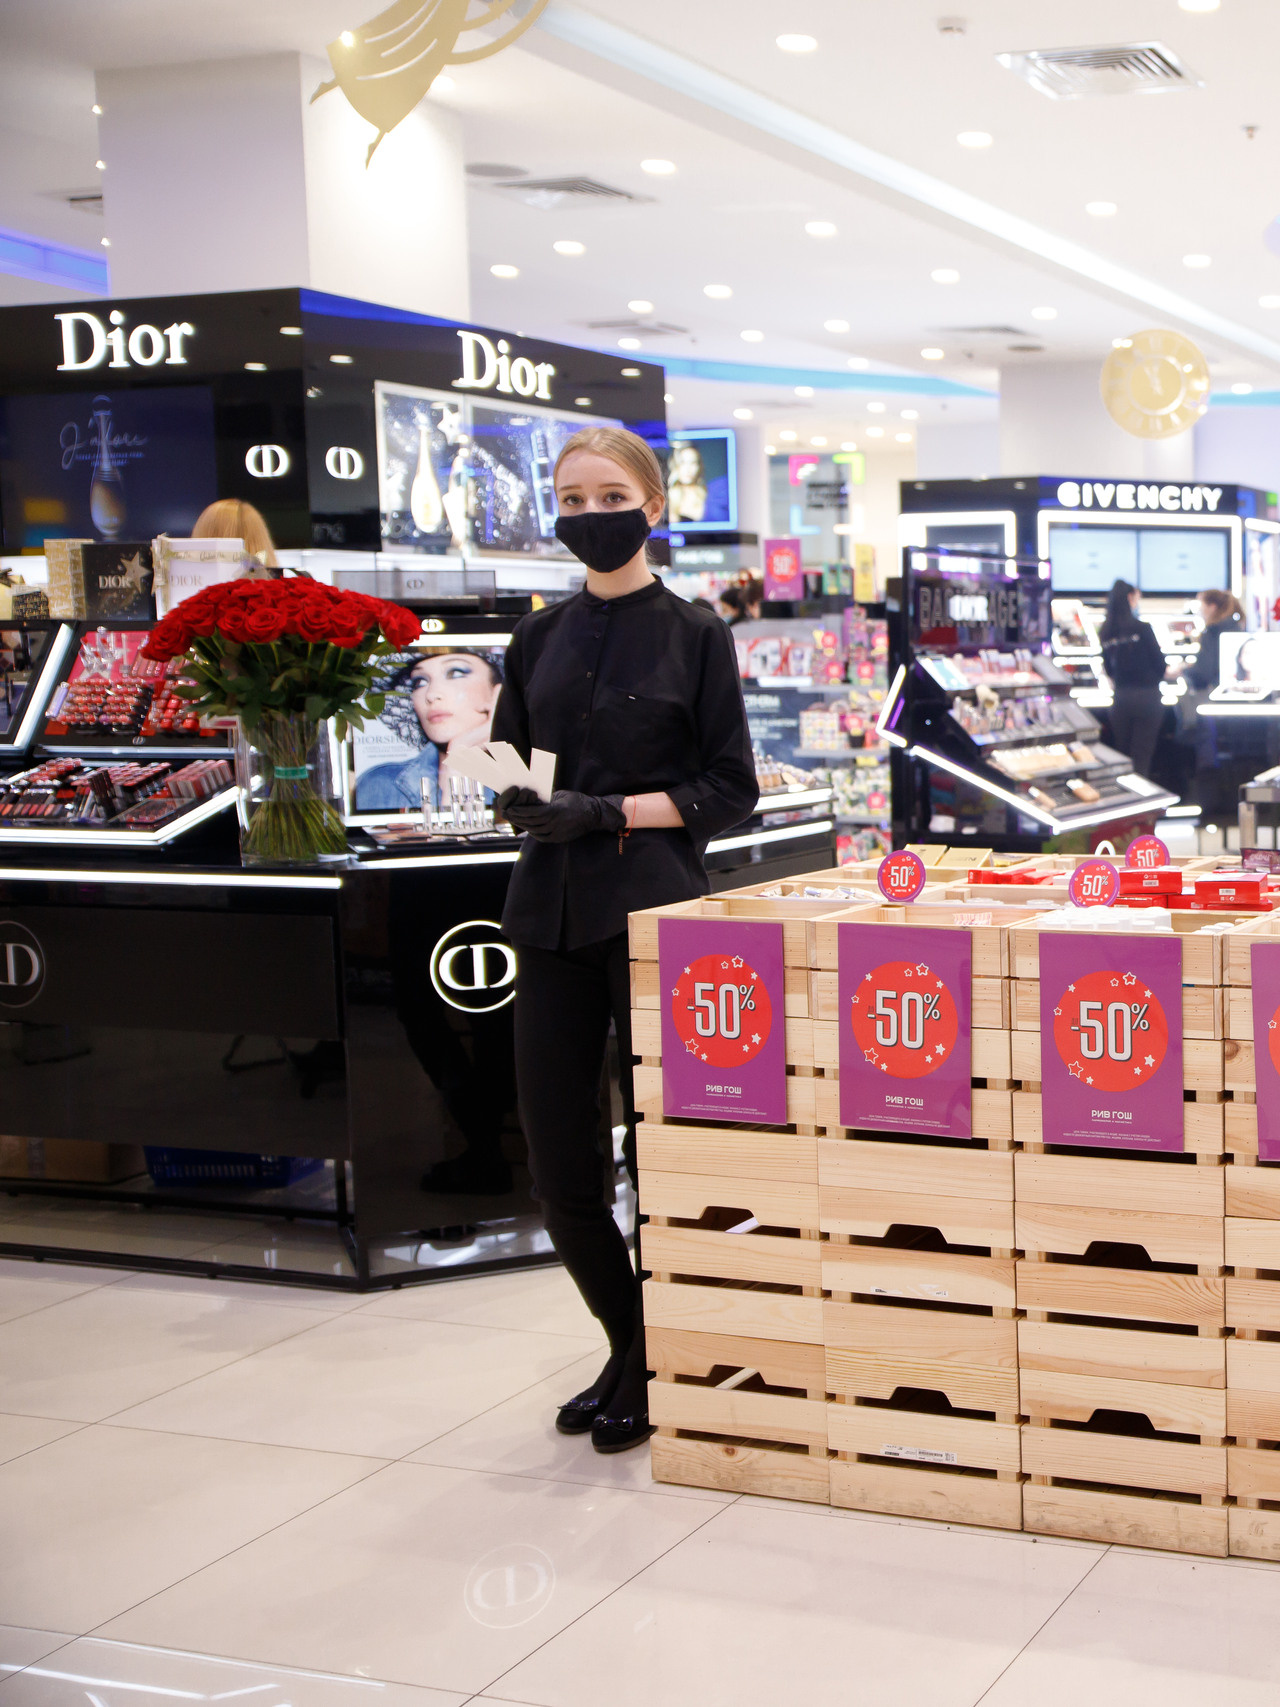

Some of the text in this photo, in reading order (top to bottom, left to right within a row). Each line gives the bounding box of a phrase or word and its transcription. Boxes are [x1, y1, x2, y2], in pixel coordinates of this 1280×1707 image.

[55, 310, 194, 371] Dior
[455, 330, 556, 399] Dior
[1056, 481, 1223, 512] GIVENCHY
[98, 575, 134, 589] DIOR
[888, 865, 915, 888] -50%
[1080, 875, 1109, 897] -50%
[686, 982, 757, 1040] -50%
[867, 989, 942, 1050] -50%
[1070, 1000, 1150, 1063] -50%
[705, 1084, 742, 1095] РИВ ГОШ
[885, 1095, 903, 1104] РИВ
[904, 1097, 924, 1107] ГОШ
[1091, 1109, 1133, 1120] РИВ ГОШ
